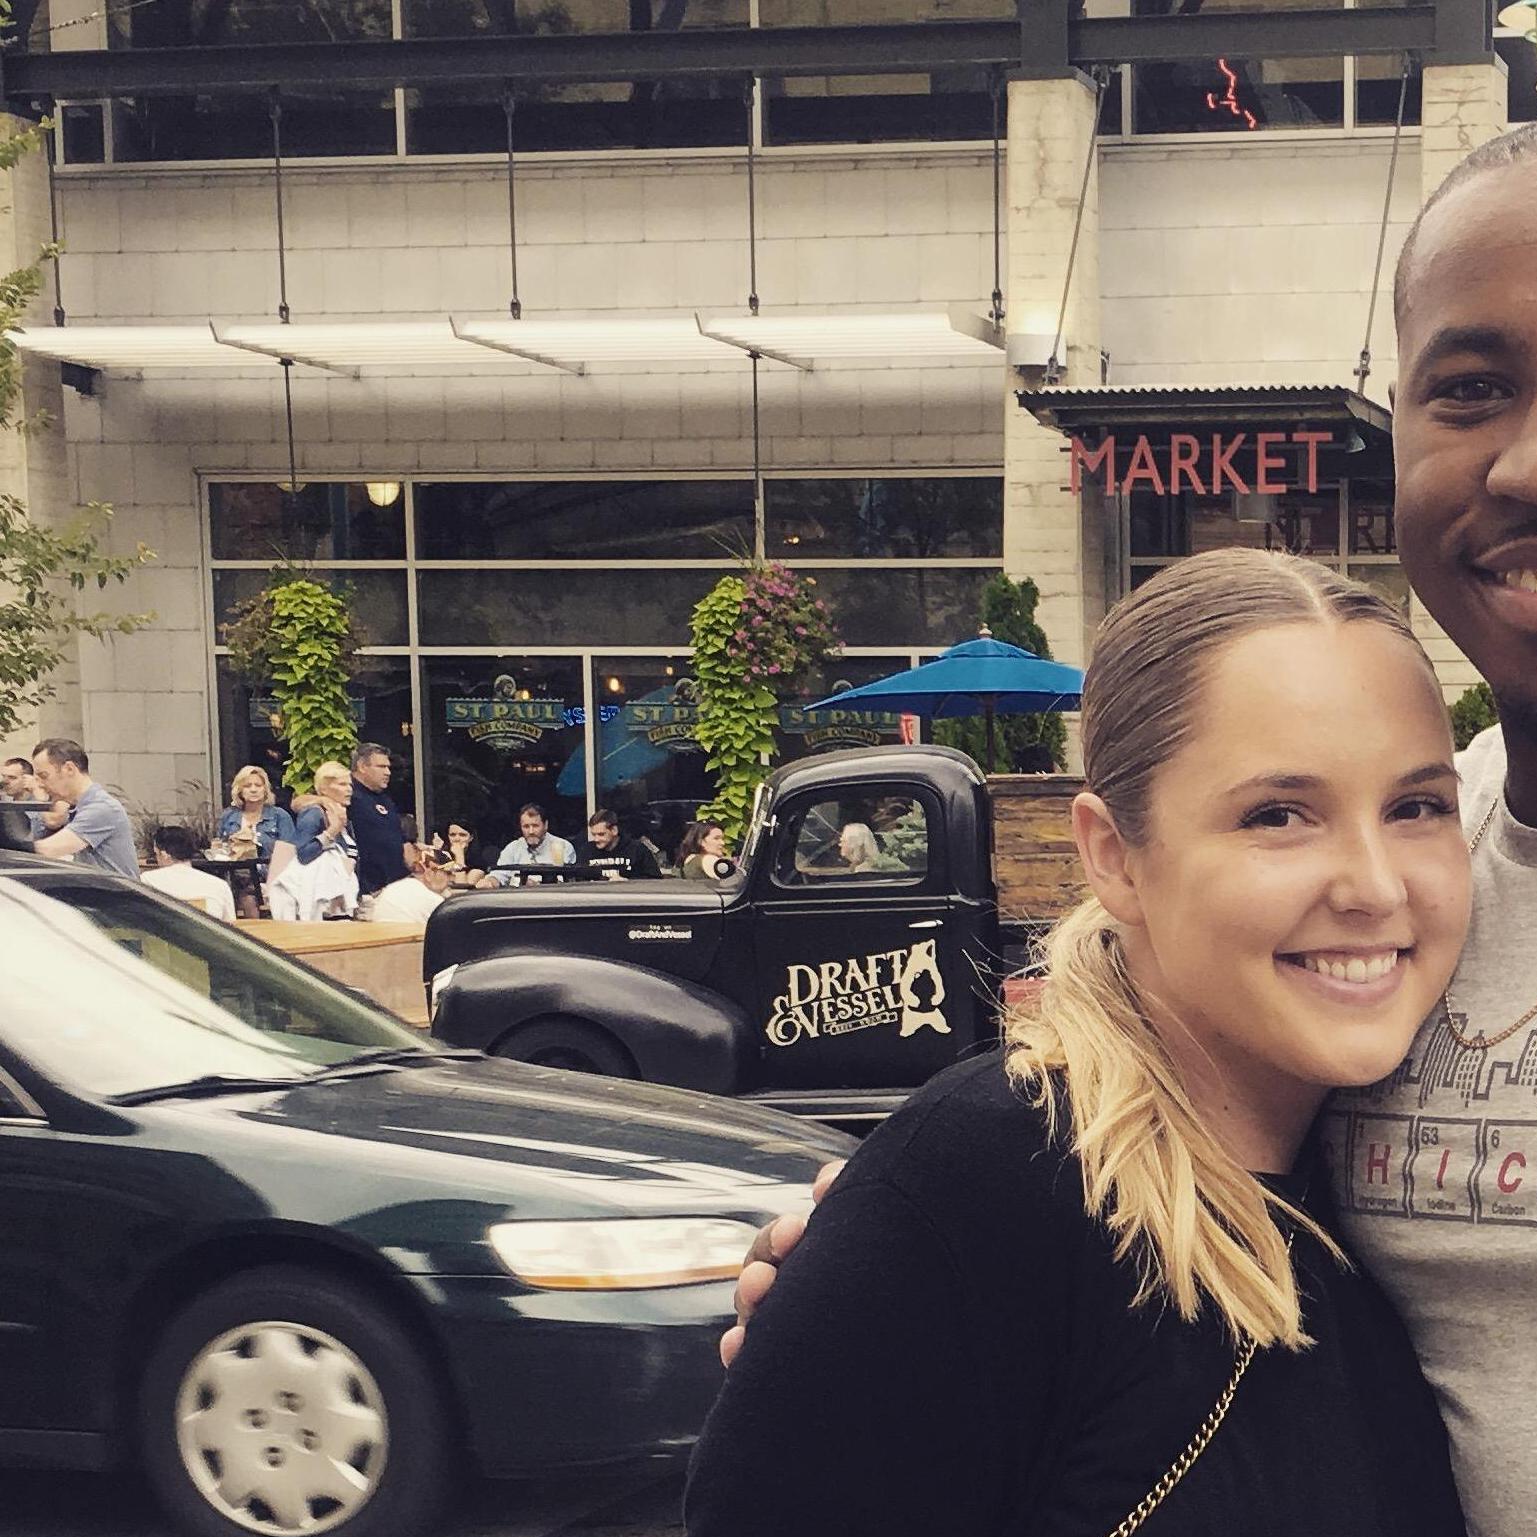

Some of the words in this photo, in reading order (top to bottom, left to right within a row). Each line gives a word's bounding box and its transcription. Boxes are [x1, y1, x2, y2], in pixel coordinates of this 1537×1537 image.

[1069, 431, 1334, 497] MARKET
[454, 702, 483, 719] ST
[494, 702, 558, 719] PAUL
[786, 949, 908, 1008] DRAFT
[791, 985, 904, 1039] VESSEL
[1420, 1126, 1439, 1146] 53
[1490, 1129, 1501, 1148] 6
[1367, 1143, 1391, 1185] H
[1496, 1152, 1527, 1194] C
[1491, 1203, 1526, 1216] Carbon
